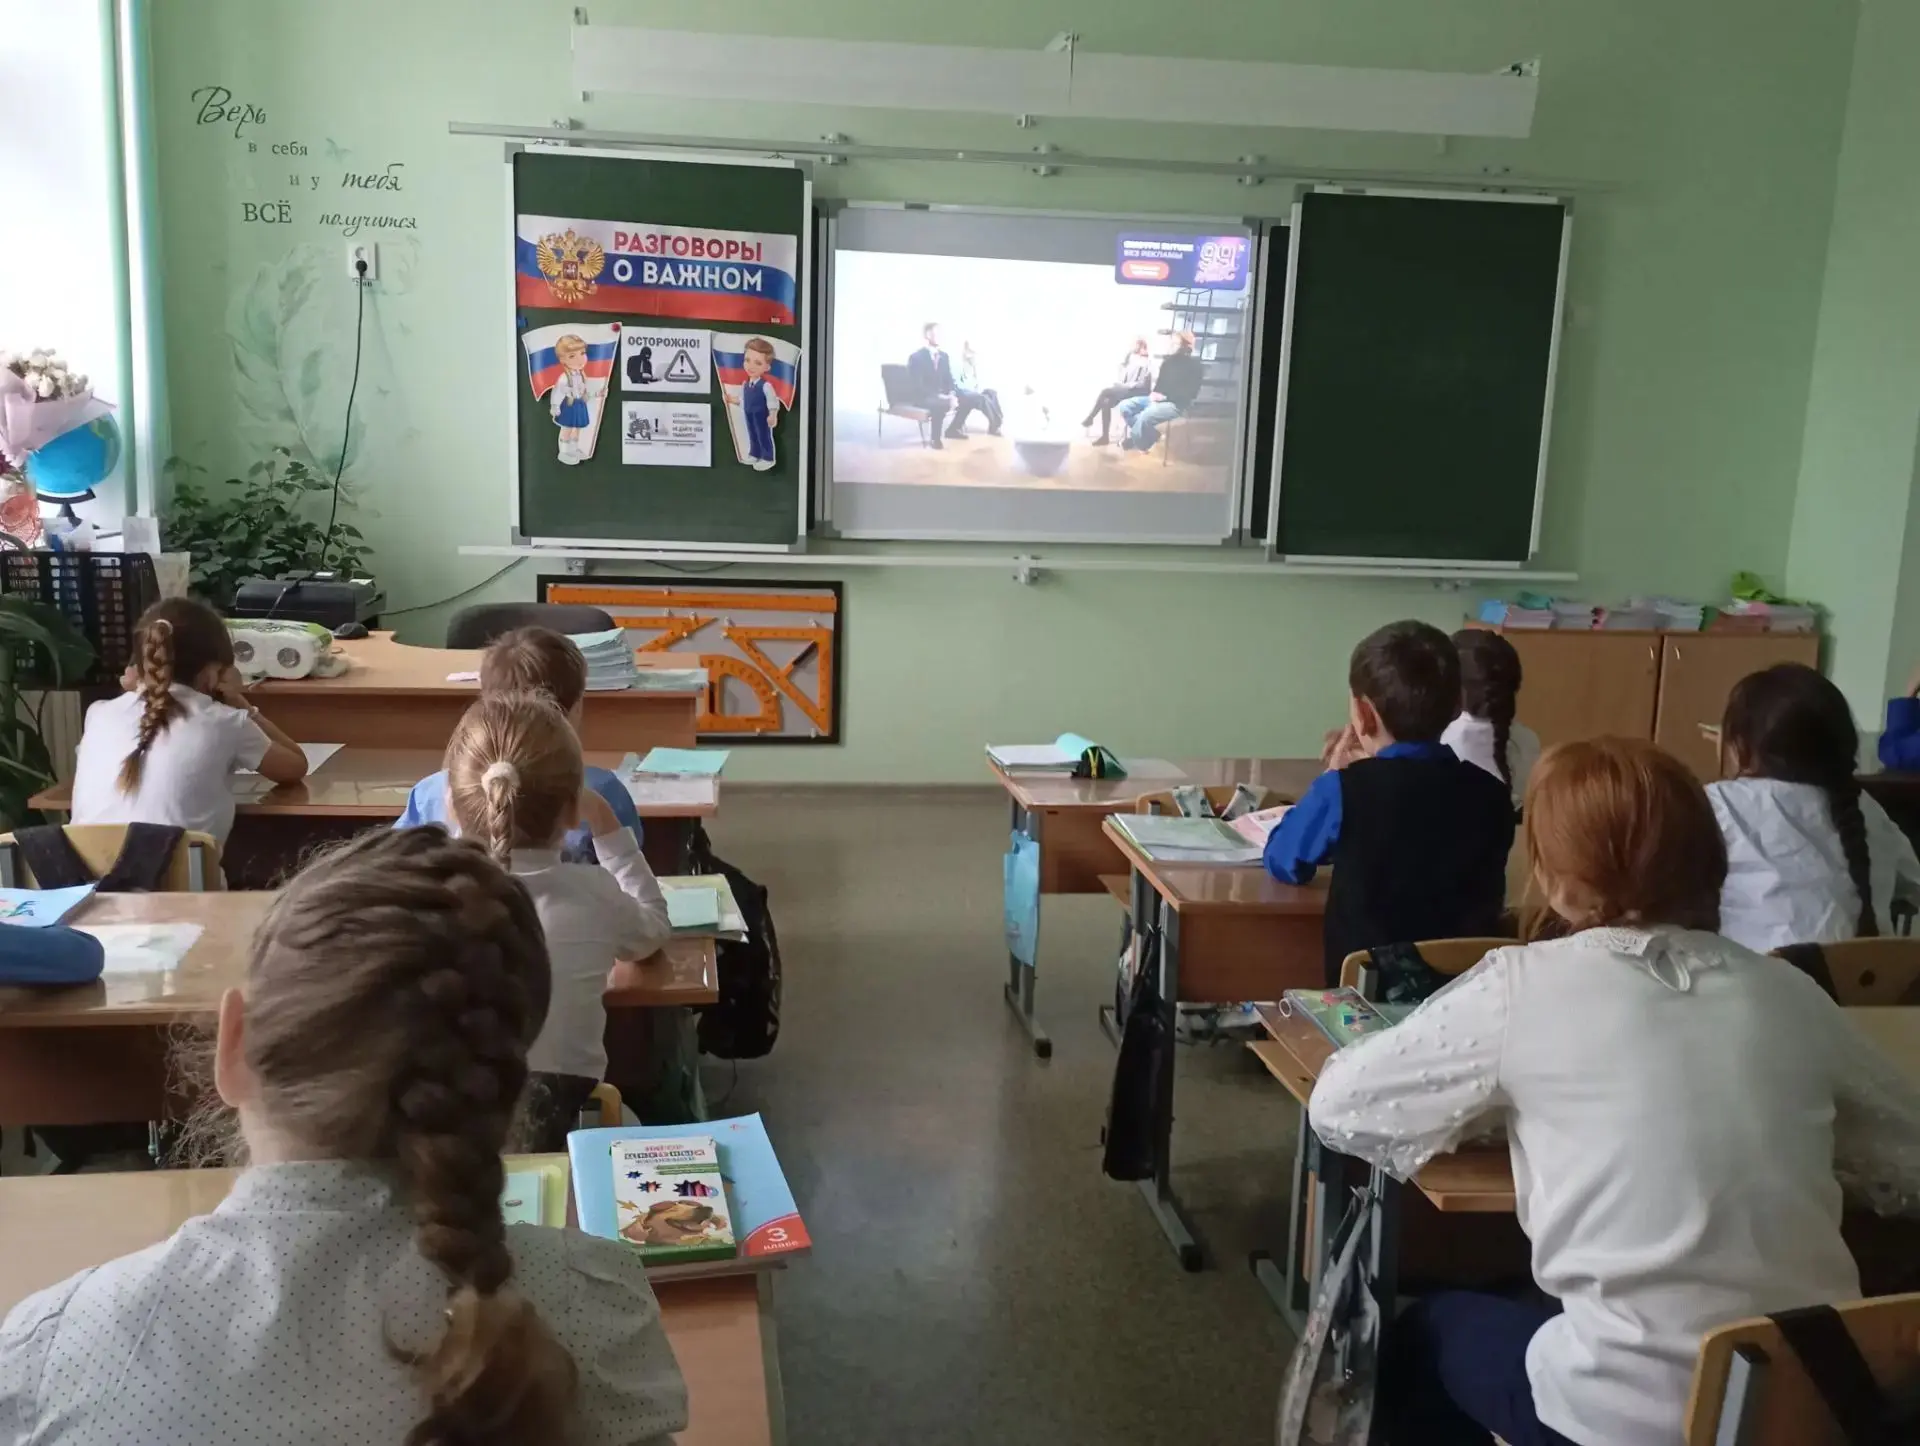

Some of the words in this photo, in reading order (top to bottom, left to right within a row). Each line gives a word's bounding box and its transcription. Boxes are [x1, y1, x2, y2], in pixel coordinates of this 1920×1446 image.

[191, 86, 267, 139] Верь
[271, 141, 308, 156] себя
[311, 175, 320, 190] у
[341, 163, 404, 192] тебя
[241, 200, 293, 223] ВСЁ
[319, 212, 418, 237] получится
[613, 231, 762, 262] РАЗГОВОРЫ
[613, 259, 632, 282] О
[642, 261, 762, 292] ВАЖНОМ
[628, 336, 700, 348] ОСТОРОЖНО!
[766, 1227, 788, 1242] 3
